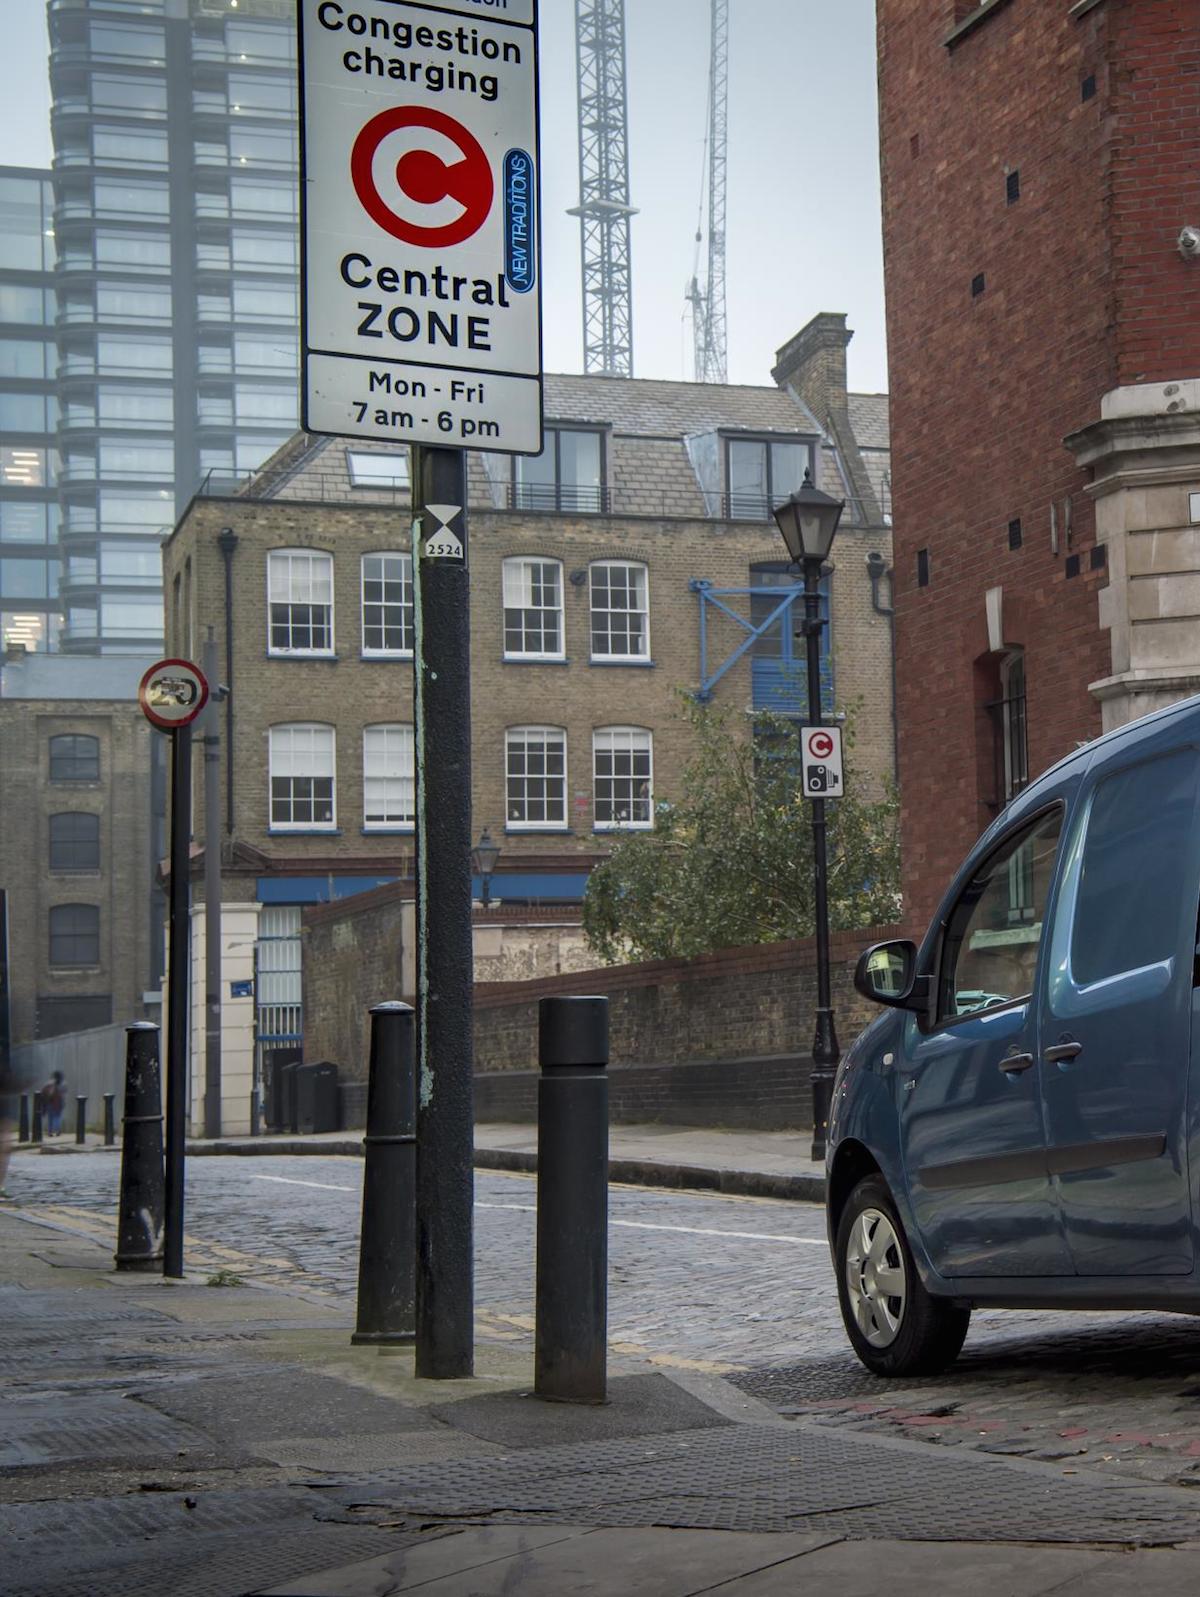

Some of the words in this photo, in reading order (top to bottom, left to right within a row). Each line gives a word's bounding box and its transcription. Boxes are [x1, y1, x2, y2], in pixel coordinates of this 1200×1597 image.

[317, 1, 522, 64] Congestion
[343, 46, 499, 101] charging
[340, 252, 511, 308] Central
[357, 302, 492, 351] ZONE
[369, 371, 426, 397] Mon
[451, 380, 484, 404] Fri
[428, 544, 461, 555] 2524
